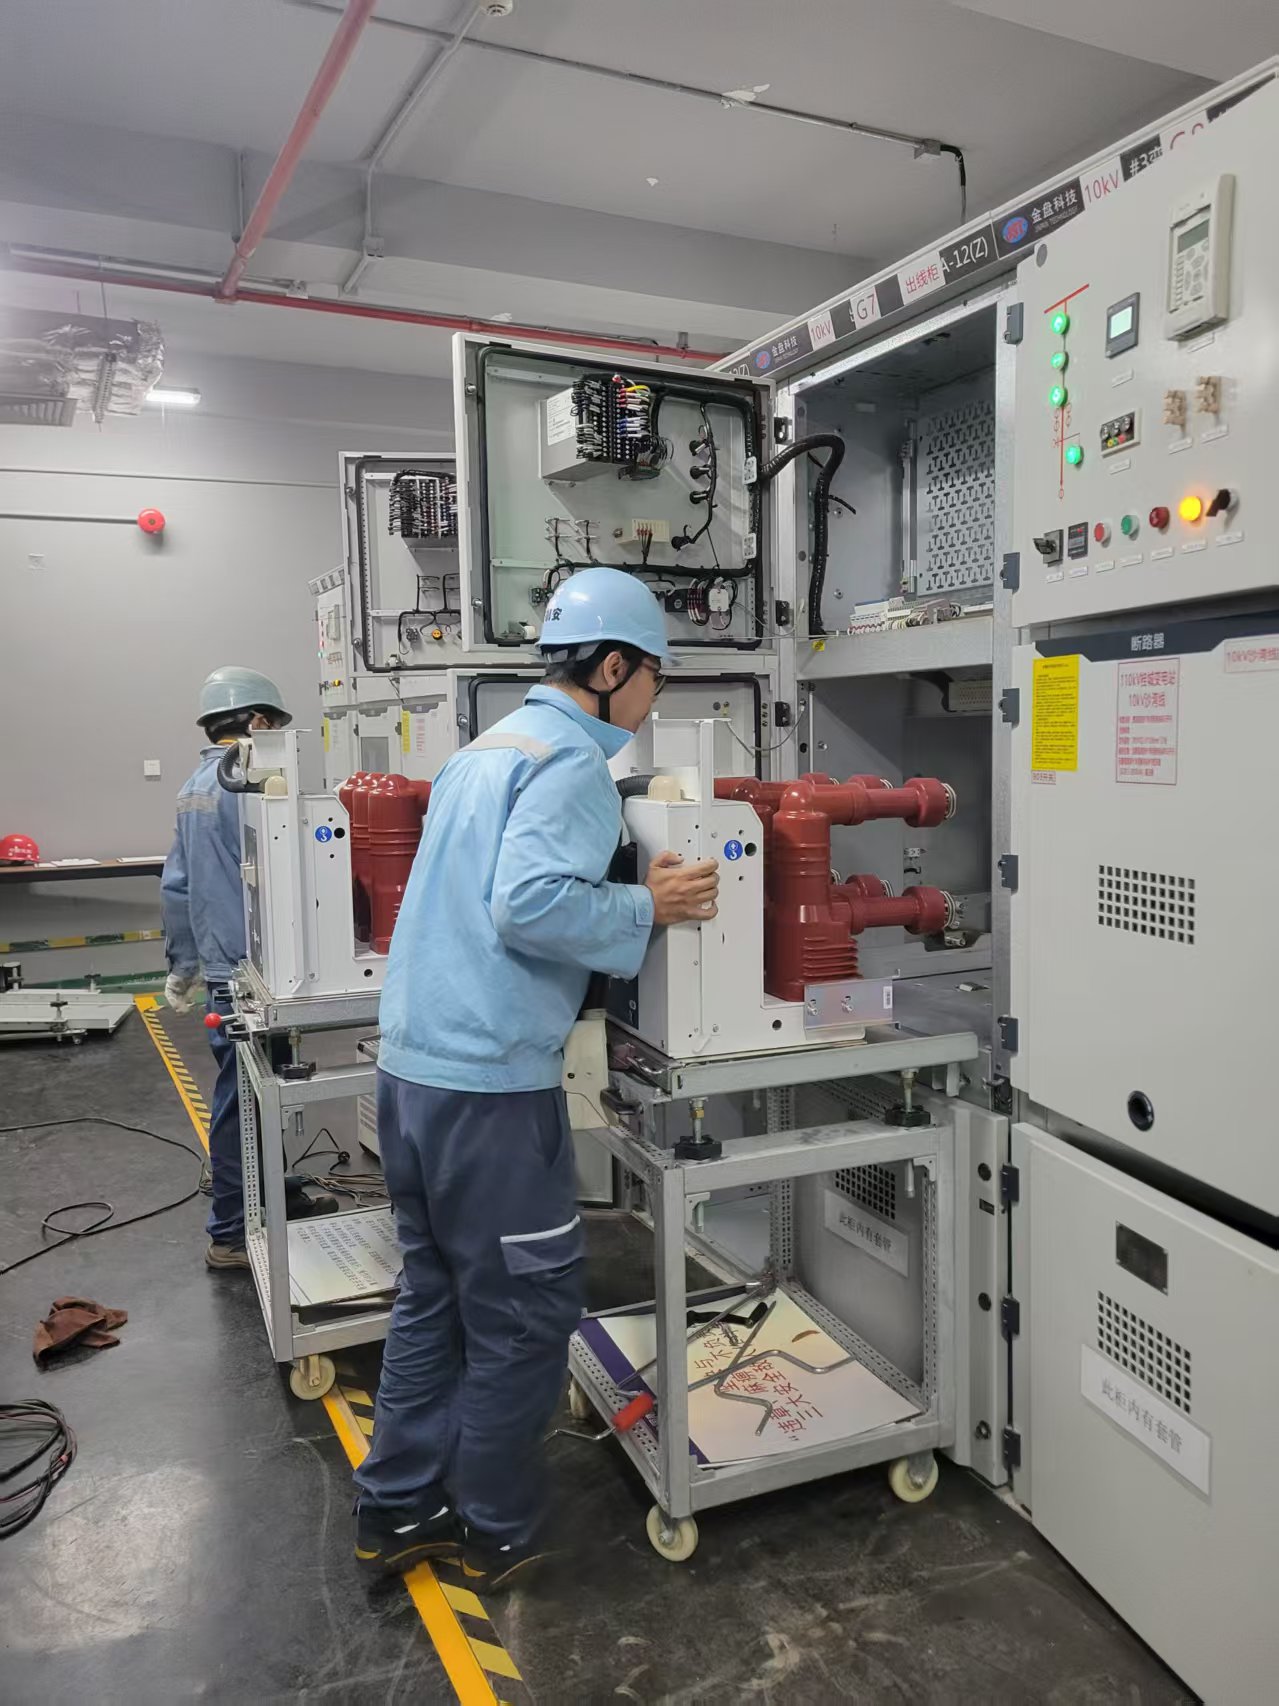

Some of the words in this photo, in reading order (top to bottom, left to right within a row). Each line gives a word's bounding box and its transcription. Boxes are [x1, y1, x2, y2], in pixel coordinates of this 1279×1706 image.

[1084, 170, 1119, 203] 10kV
[1031, 188, 1078, 224] 金盘科技
[905, 263, 940, 294] 出线柜
[856, 293, 875, 320] G7
[811, 319, 832, 341] 10kV
[772, 335, 798, 357] 金盘科技
[1131, 632, 1165, 651] 断路器
[1101, 1377, 1183, 1454] 此柜内有套管
